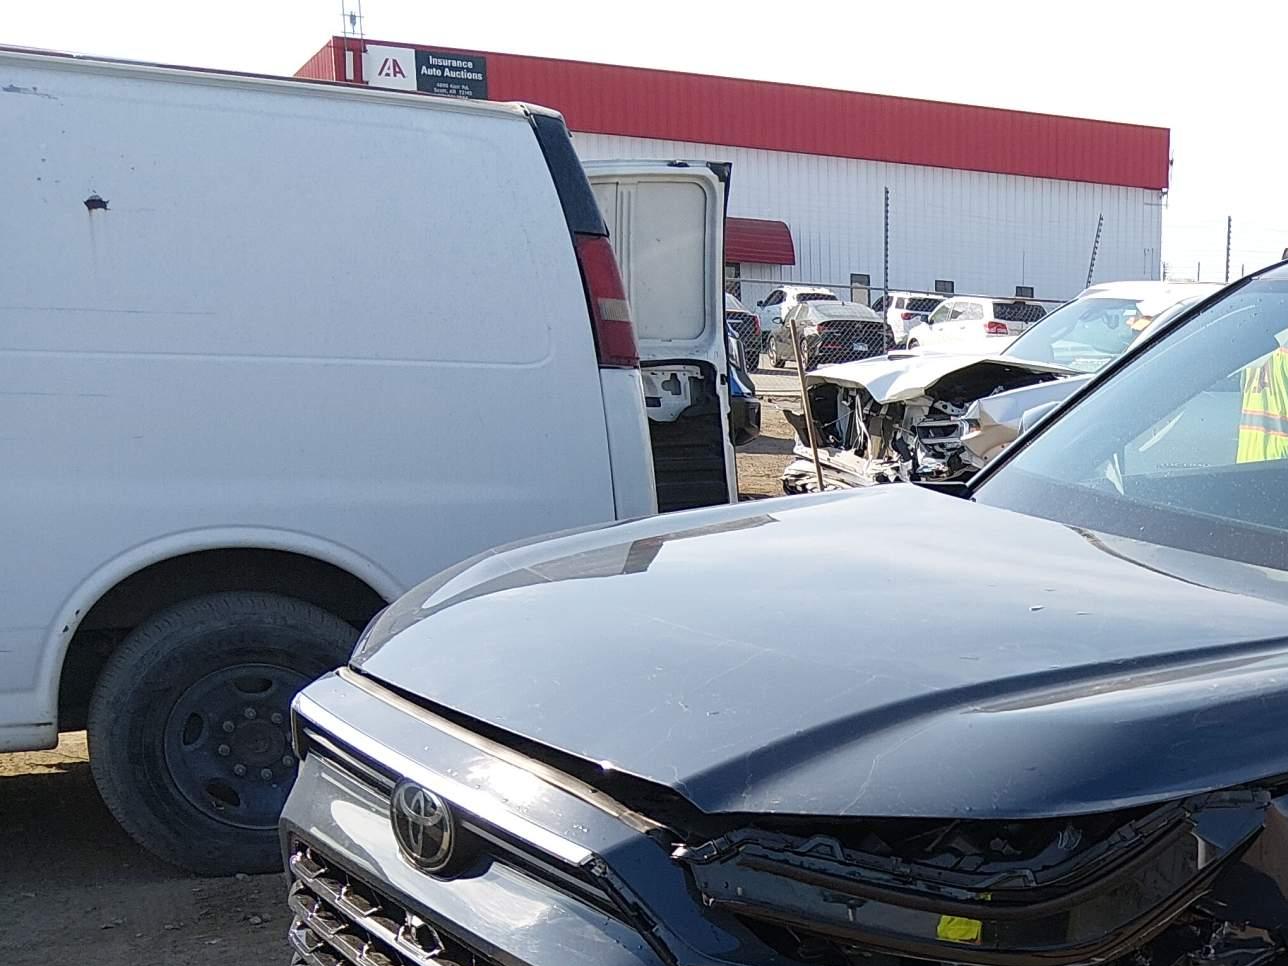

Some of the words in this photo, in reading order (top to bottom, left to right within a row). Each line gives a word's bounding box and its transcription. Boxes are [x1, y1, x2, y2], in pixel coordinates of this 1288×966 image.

[429, 55, 473, 69] Insurance
[421, 65, 442, 77] Auto
[444, 67, 483, 80] Auctions
